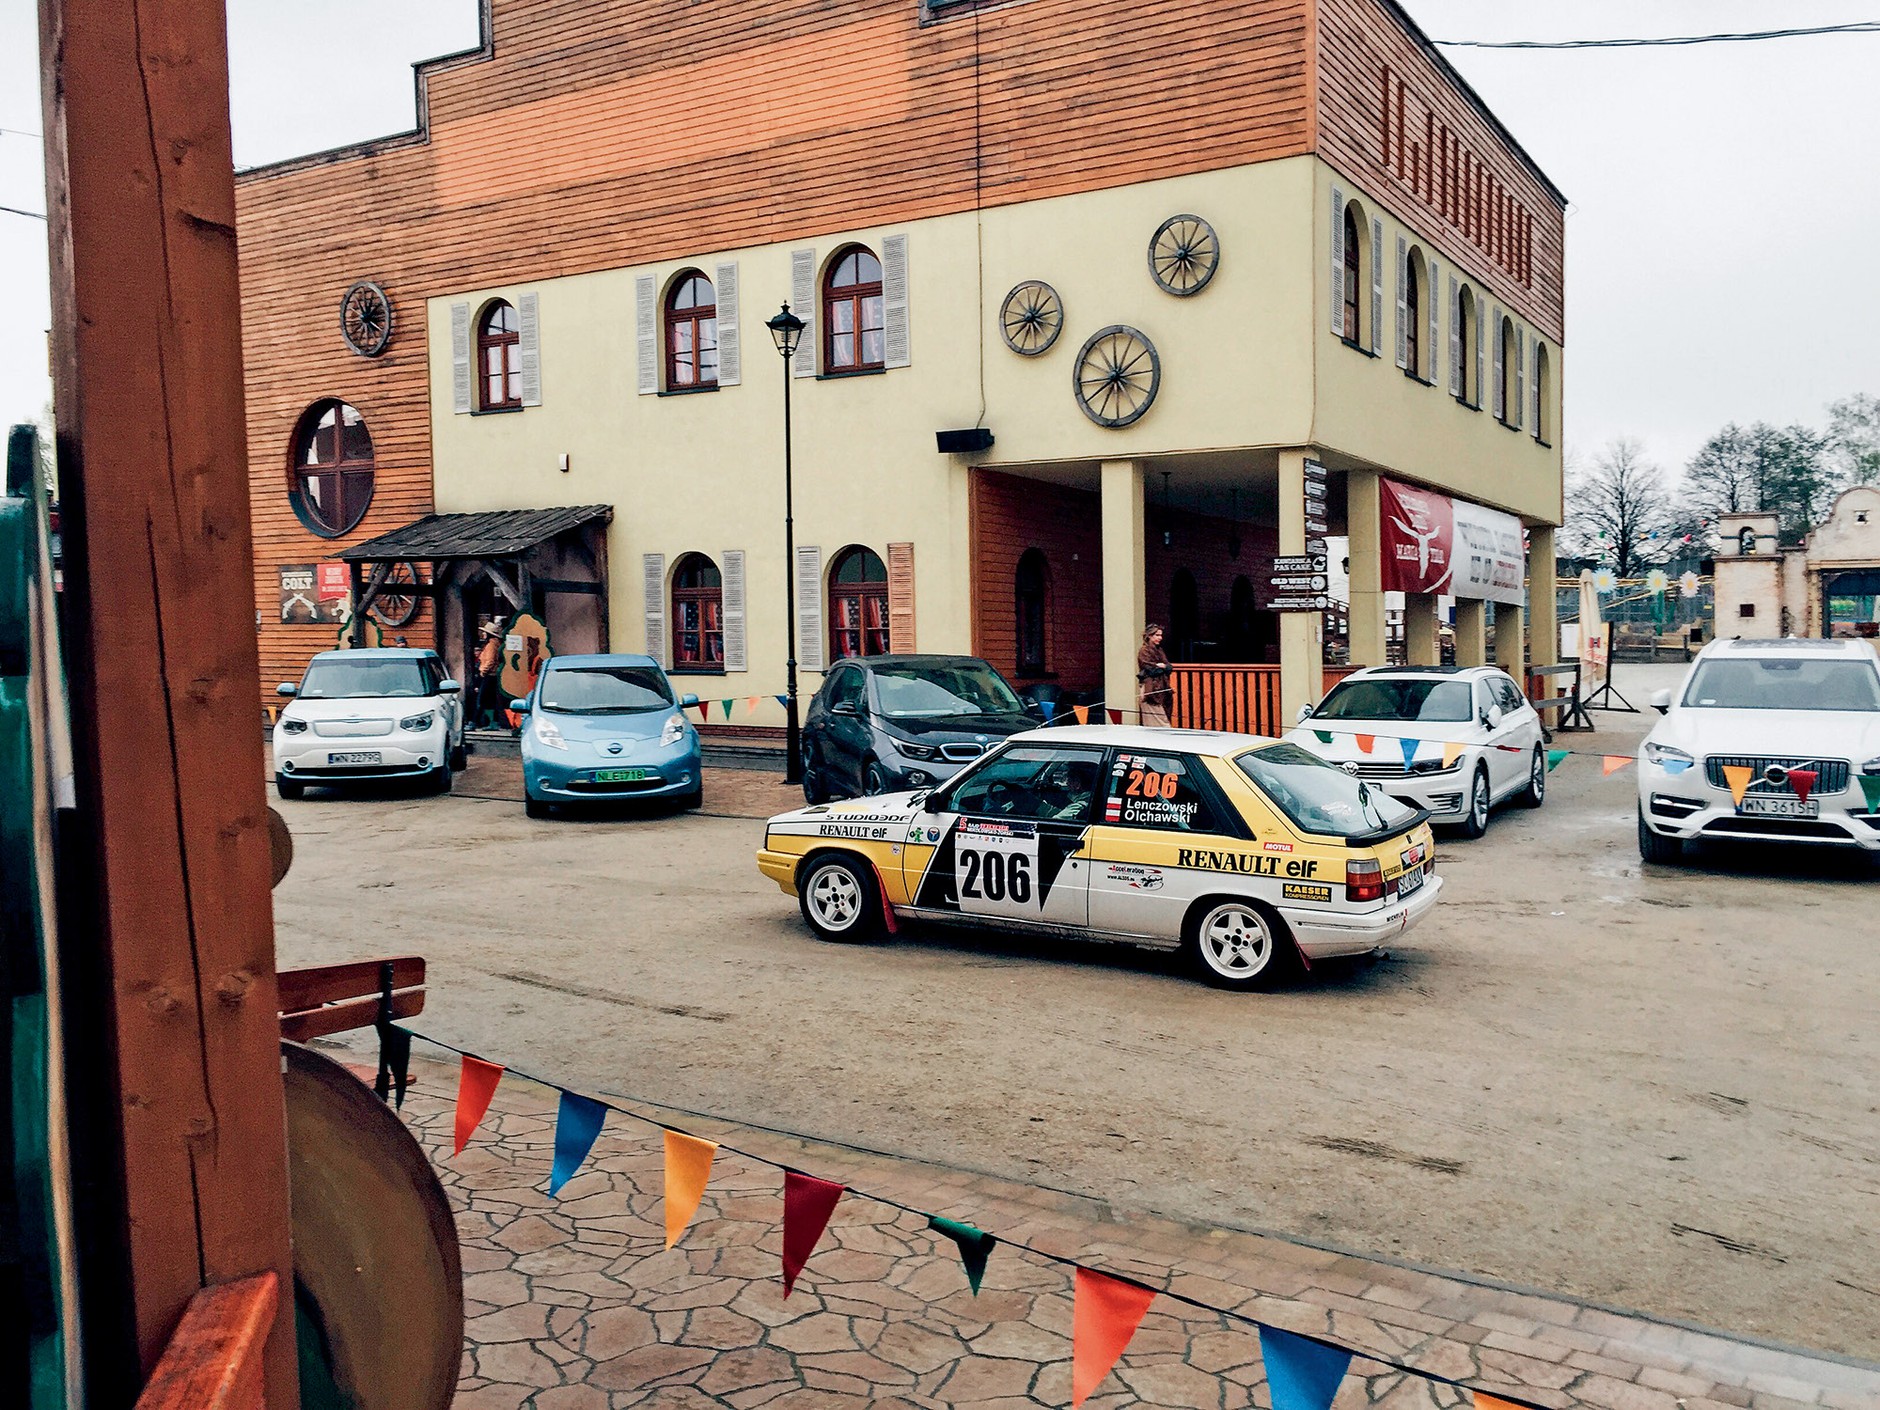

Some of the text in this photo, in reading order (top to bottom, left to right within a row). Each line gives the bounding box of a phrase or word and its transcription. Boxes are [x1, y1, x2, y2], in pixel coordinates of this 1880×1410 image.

[282, 577, 313, 590] COLT
[1126, 770, 1179, 799] 206
[1126, 797, 1198, 814] Lenczowski
[1744, 799, 1766, 812] WN
[1124, 809, 1191, 824] Olchawski
[819, 824, 888, 839] RENAULT elf
[1265, 843, 1292, 851] MOTUL
[1177, 848, 1318, 878] RENAULT elf
[959, 849, 1031, 904] 206
[1284, 892, 1329, 901] KOMPRESSOREN
[1285, 884, 1329, 896] KAESER
